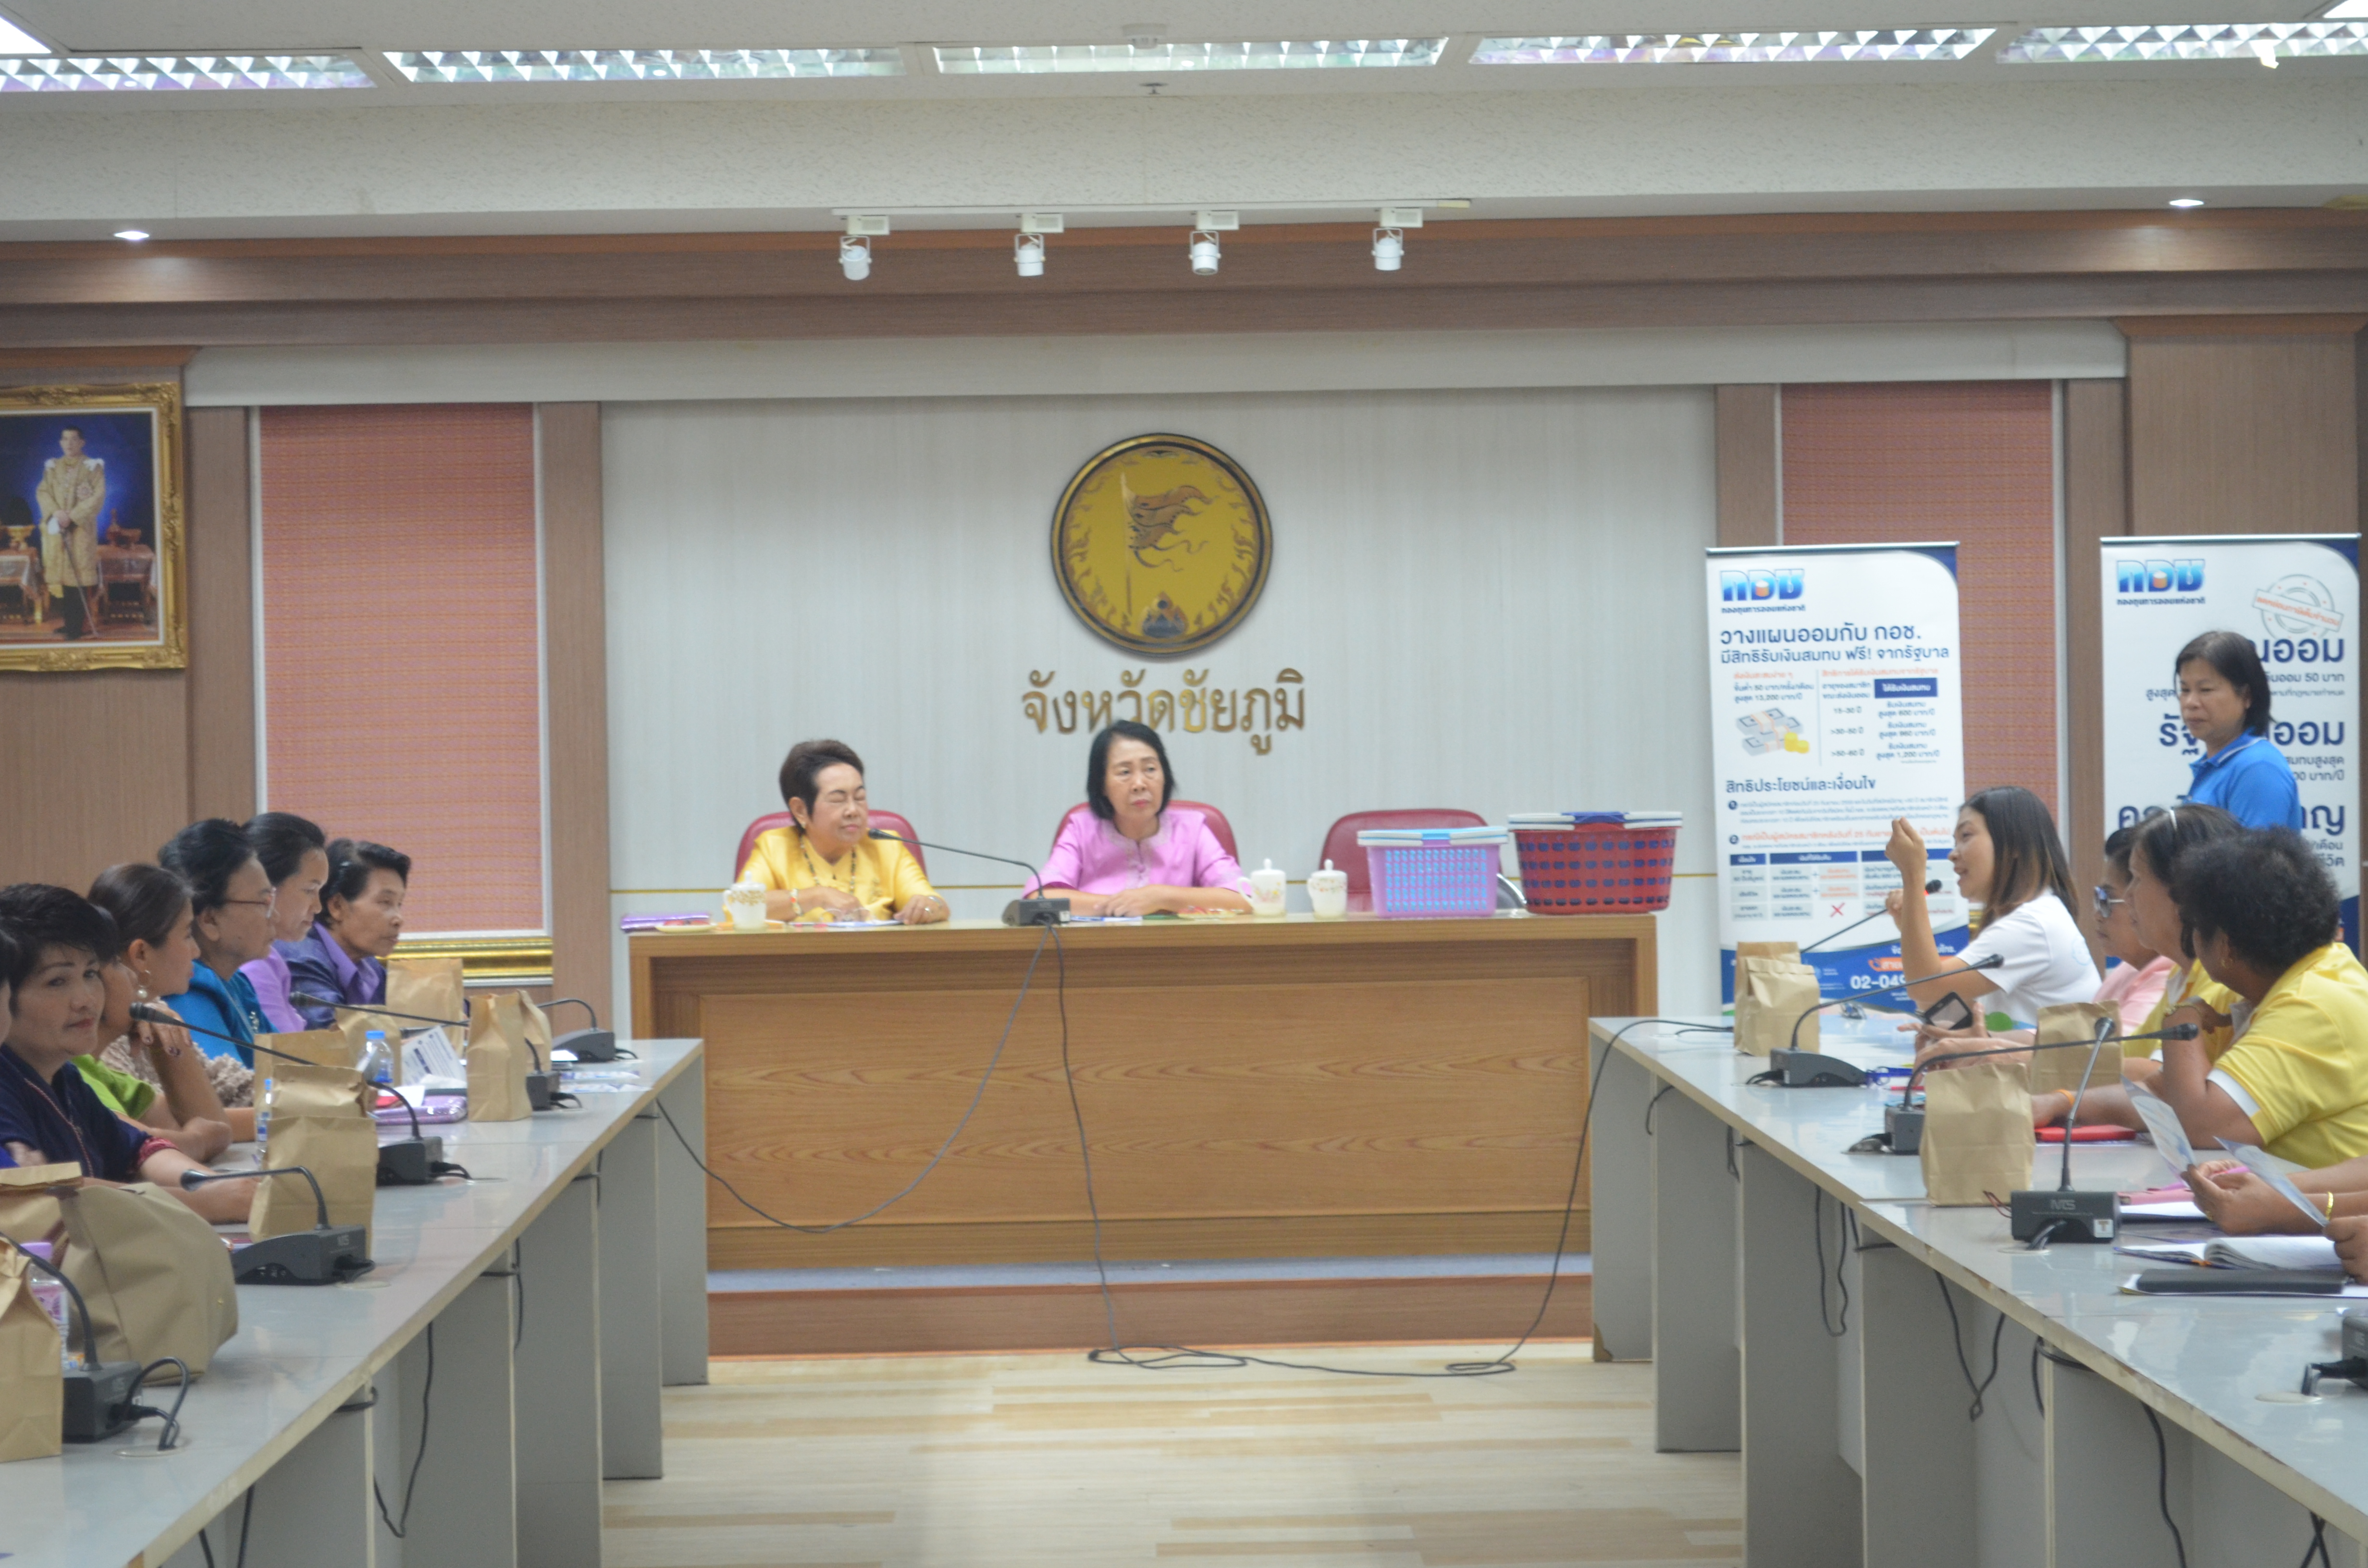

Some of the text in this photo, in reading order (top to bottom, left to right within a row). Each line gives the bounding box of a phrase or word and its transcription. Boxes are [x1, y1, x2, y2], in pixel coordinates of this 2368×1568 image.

[1721, 622, 1922, 644] วางแผนออมกับ กอช.
[1721, 645, 1949, 663] มีสิทธิรับเงินสมทบ ฟรี! จากรัฐบาล
[2305, 673, 2319, 682] 50
[2322, 674, 2345, 682] บาท
[1022, 667, 1305, 755] จังหวัดชัยภูมิ
[1726, 772, 1876, 793] สิทธิประโยชน์และเงื่อนไข
[2309, 769, 2345, 782] บาท/ปี
